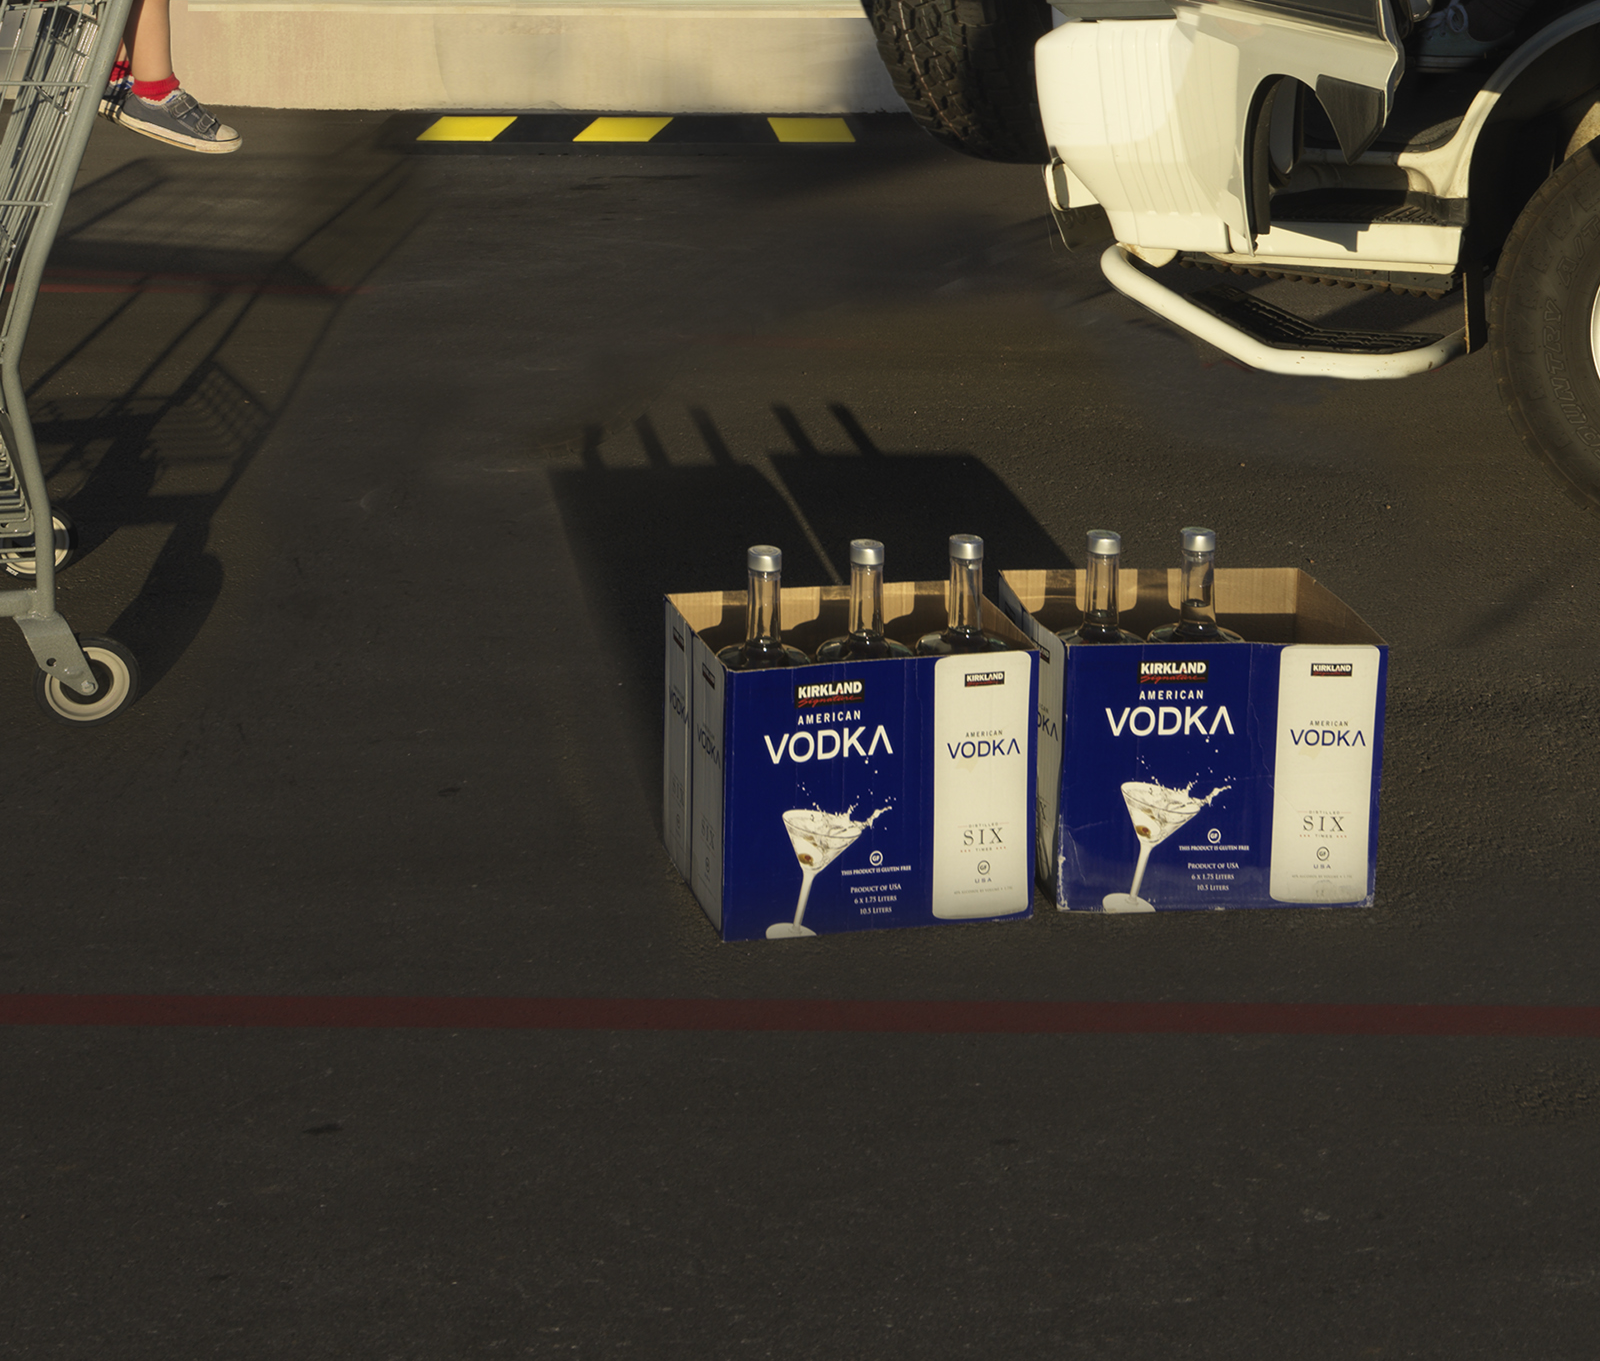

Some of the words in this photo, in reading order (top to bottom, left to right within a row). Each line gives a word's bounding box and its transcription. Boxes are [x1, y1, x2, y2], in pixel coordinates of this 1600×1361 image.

[1140, 662, 1207, 674] KIRKLAND
[1313, 664, 1352, 672] KIRKLAND
[966, 672, 1004, 682] KIRKLAND
[1140, 674, 1206, 684] Signature
[798, 681, 863, 699] KIRKLAND
[1139, 690, 1204, 700] AMERICAN
[798, 695, 862, 708] Signature
[798, 710, 861, 725] AMERICAN
[1105, 705, 1235, 736] VODKA
[965, 730, 1003, 738] AMERICAN
[1038, 711, 1058, 742] DKA
[764, 725, 893, 764] VODKA
[1290, 729, 1366, 747] VODKA
[947, 738, 1021, 759] VODKA
[1303, 815, 1344, 832] SIX
[963, 827, 1003, 846] SIX
[860, 907, 871, 915] 10.5
